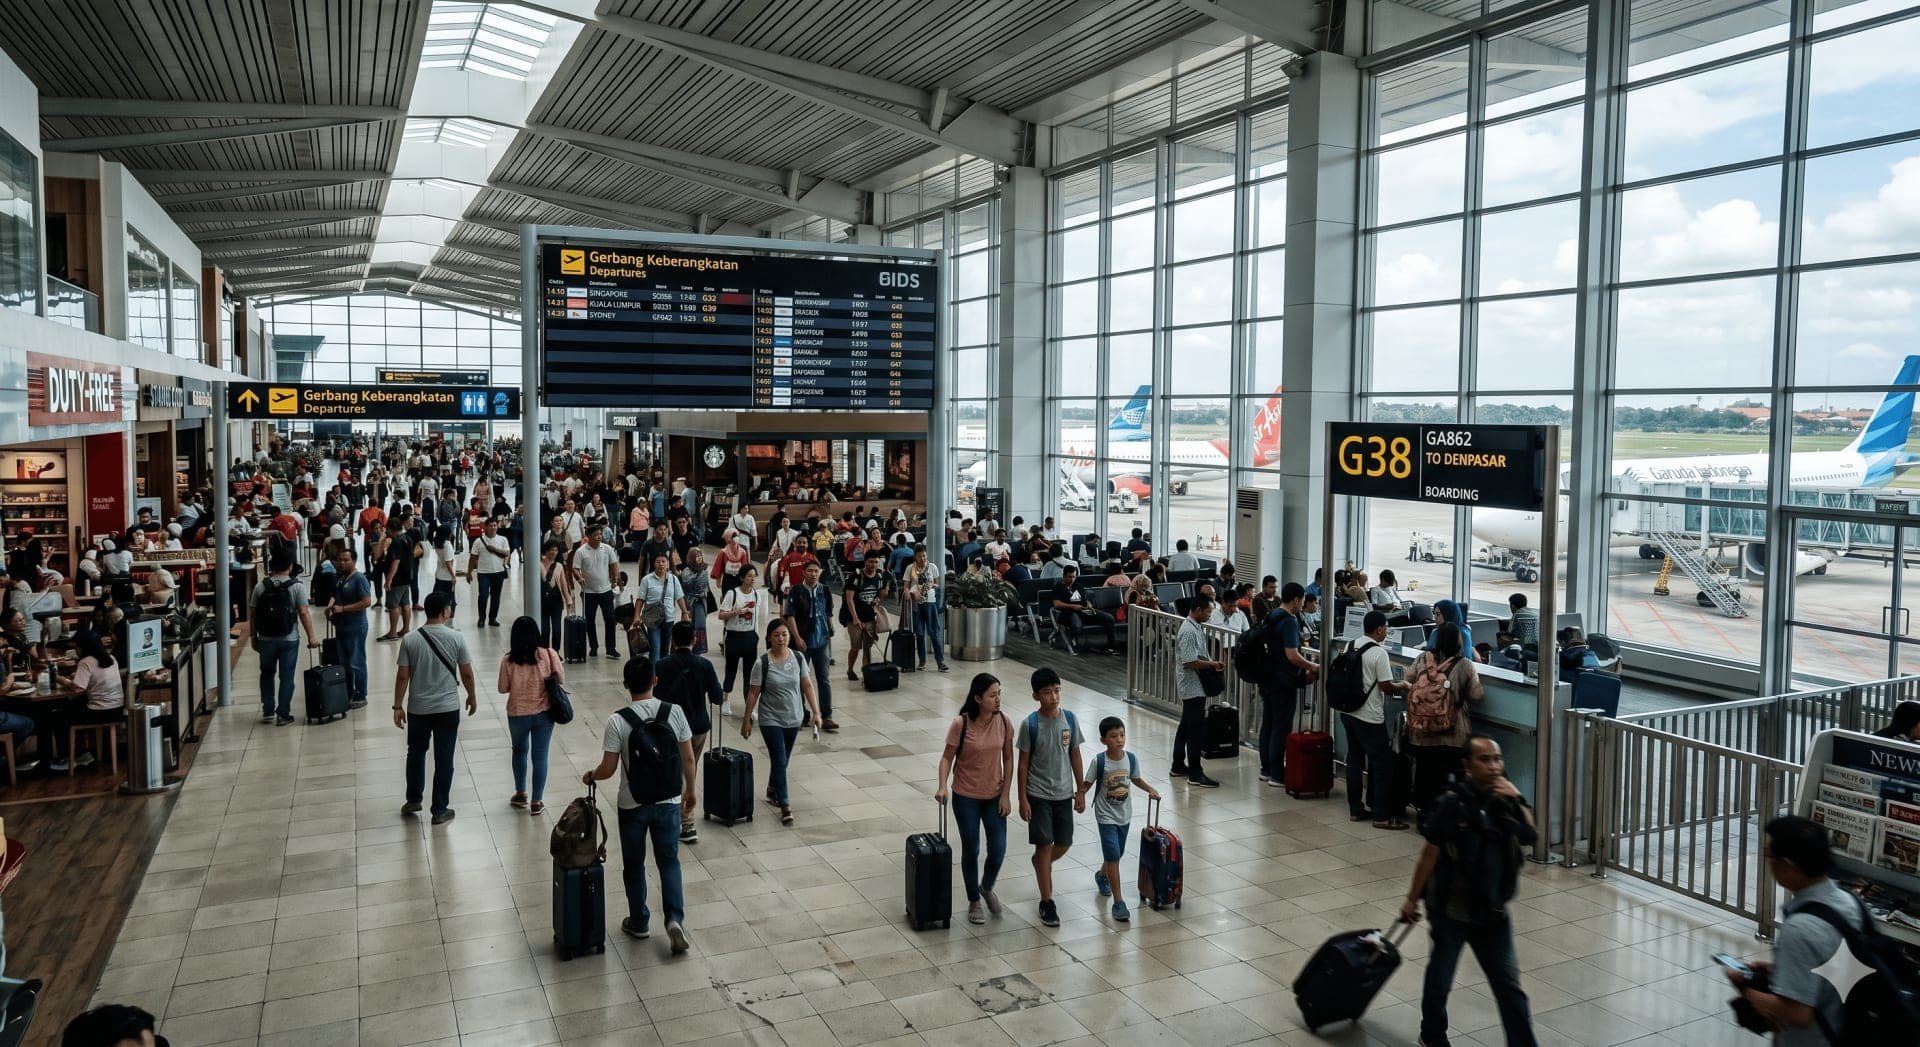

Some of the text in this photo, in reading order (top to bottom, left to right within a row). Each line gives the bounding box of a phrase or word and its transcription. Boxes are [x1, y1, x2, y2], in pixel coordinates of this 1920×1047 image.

[589, 251, 739, 271] Gerbang Keberangkatan
[589, 266, 647, 278] Departures
[589, 290, 629, 298] SINGAPORE
[613, 301, 642, 309] LUMPUR
[48, 367, 116, 413] DUTY-FREE
[304, 389, 454, 404] Gerbang Keberangkatan
[304, 403, 366, 416] Departures
[1426, 430, 1472, 447] GA862
[1338, 435, 1412, 479] G38
[1426, 452, 1507, 468] TO DENPASAR
[1425, 485, 1479, 501] BOARDING
